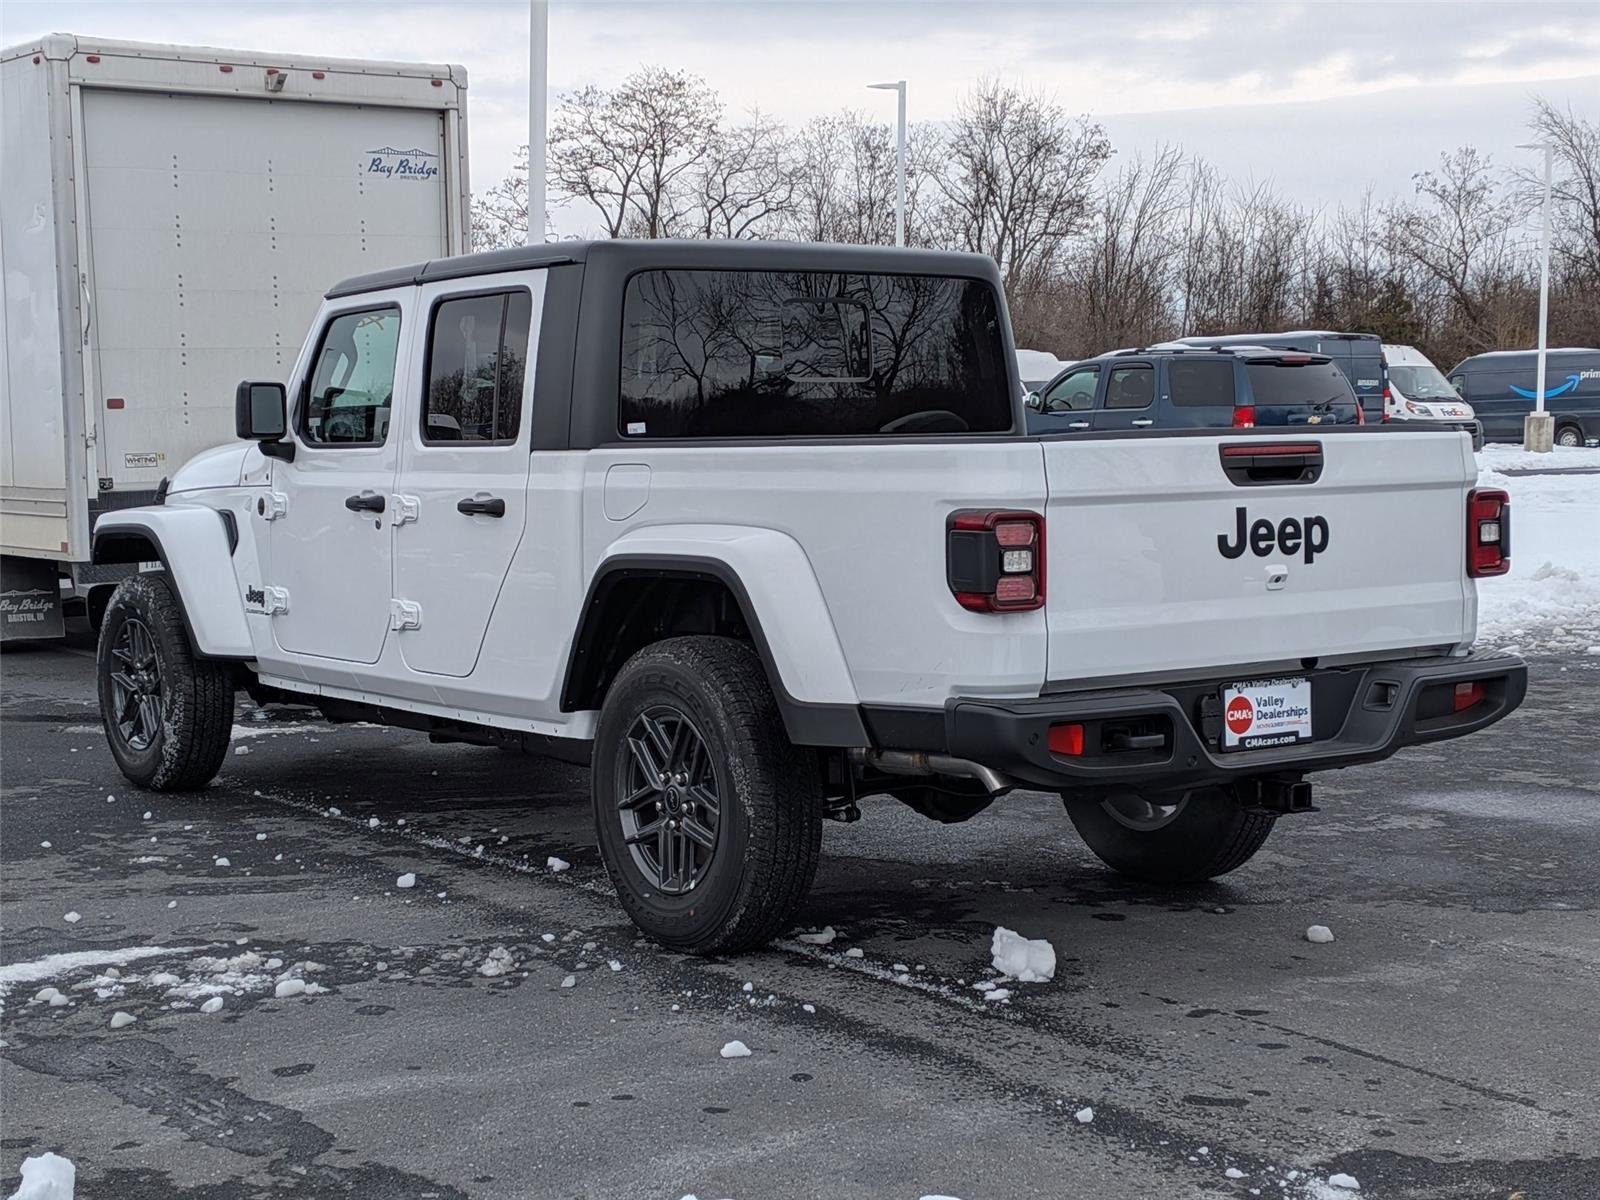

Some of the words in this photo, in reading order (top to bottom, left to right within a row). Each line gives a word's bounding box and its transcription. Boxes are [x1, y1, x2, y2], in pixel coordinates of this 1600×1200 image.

[368, 157, 393, 178] Bay
[395, 159, 438, 180] Bridge
[1440, 407, 1464, 417] FedEx
[127, 456, 156, 464] WHITING
[1217, 507, 1330, 565] Jeep
[245, 584, 265, 608] Jeep
[0, 599, 19, 613] Bay
[19, 599, 54, 612] Bridge
[1252, 680, 1270, 688] Valley
[1255, 696, 1285, 708] Valley
[1227, 709, 1253, 720] CMA's
[1256, 706, 1308, 719] Dealerships
[1245, 736, 1296, 747] CMAcars.com
